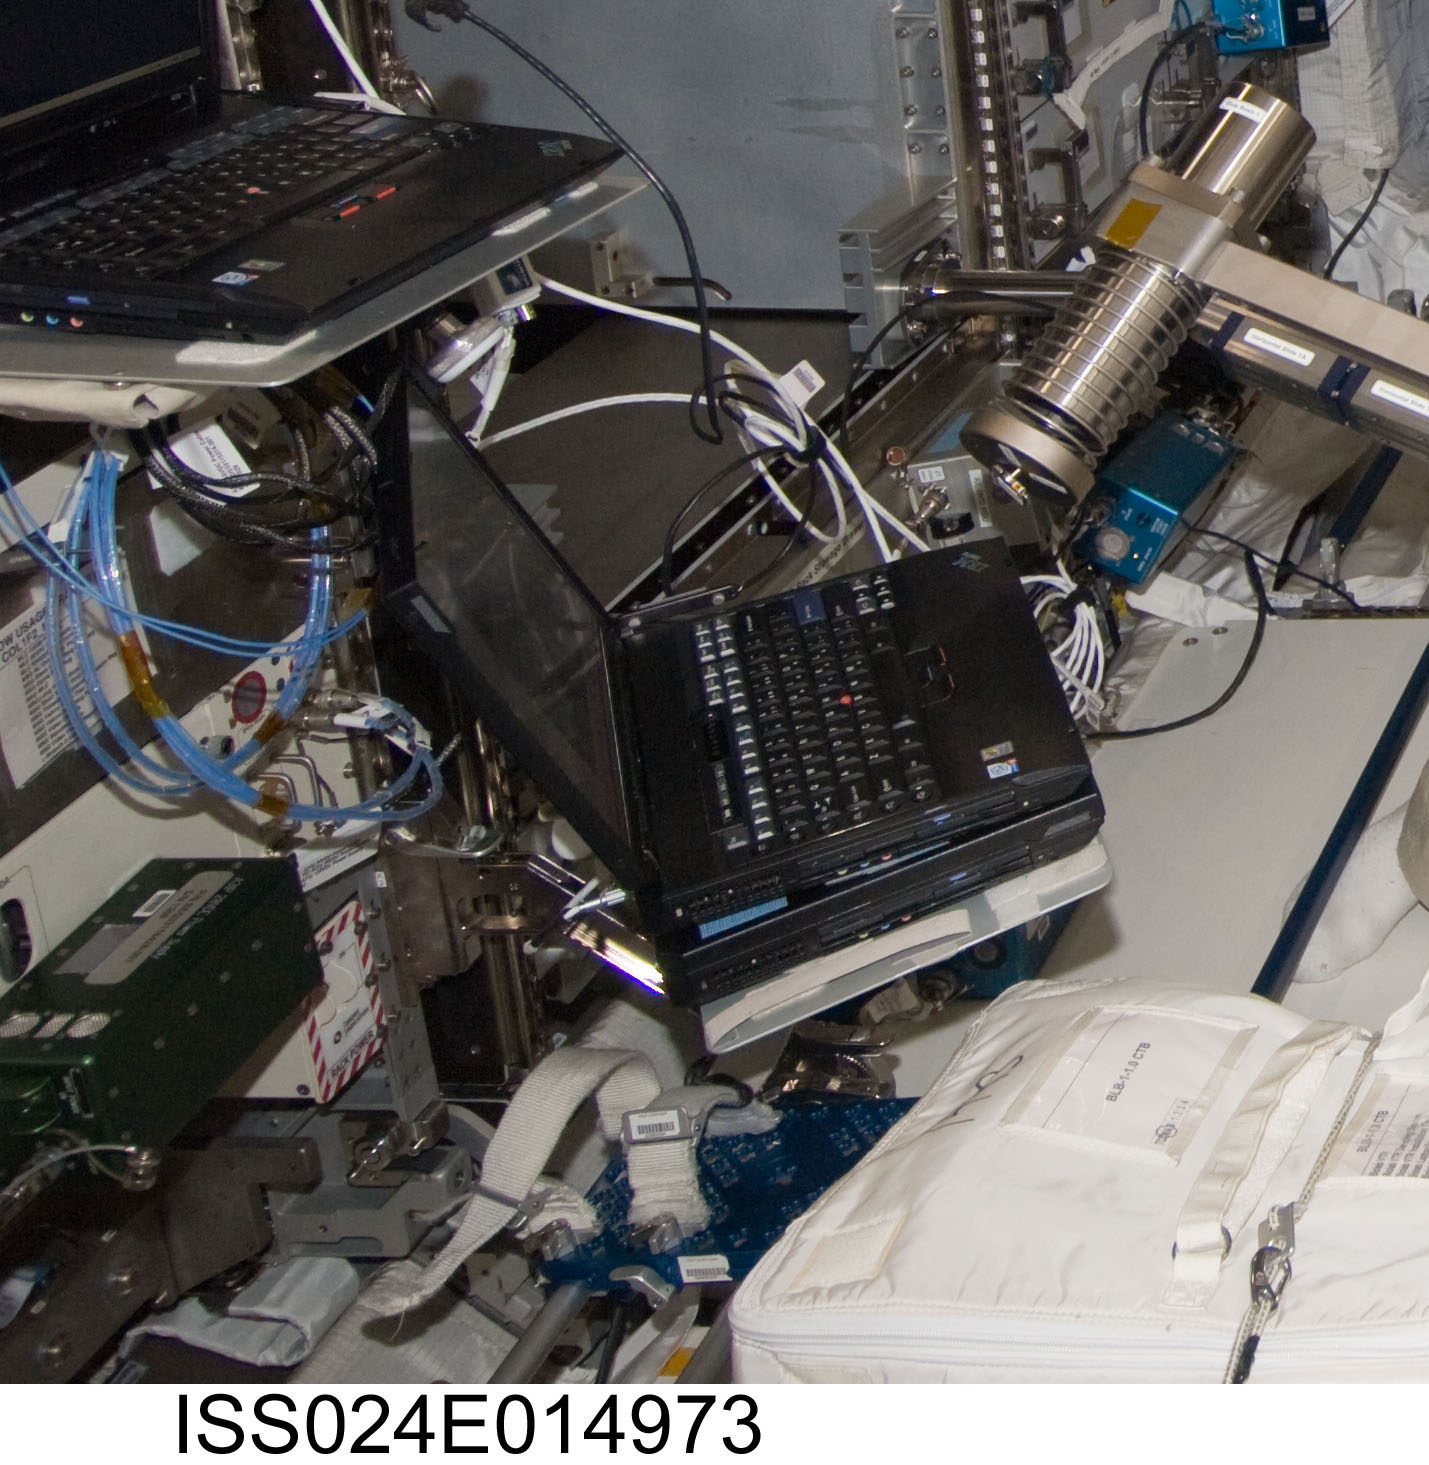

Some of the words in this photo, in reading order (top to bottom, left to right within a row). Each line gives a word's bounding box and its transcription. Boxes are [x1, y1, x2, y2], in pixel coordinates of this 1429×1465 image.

[330, 1054, 352, 1080] RACK
[350, 1031, 375, 1062] POWER
[1131, 1042, 1152, 1060] CTB
